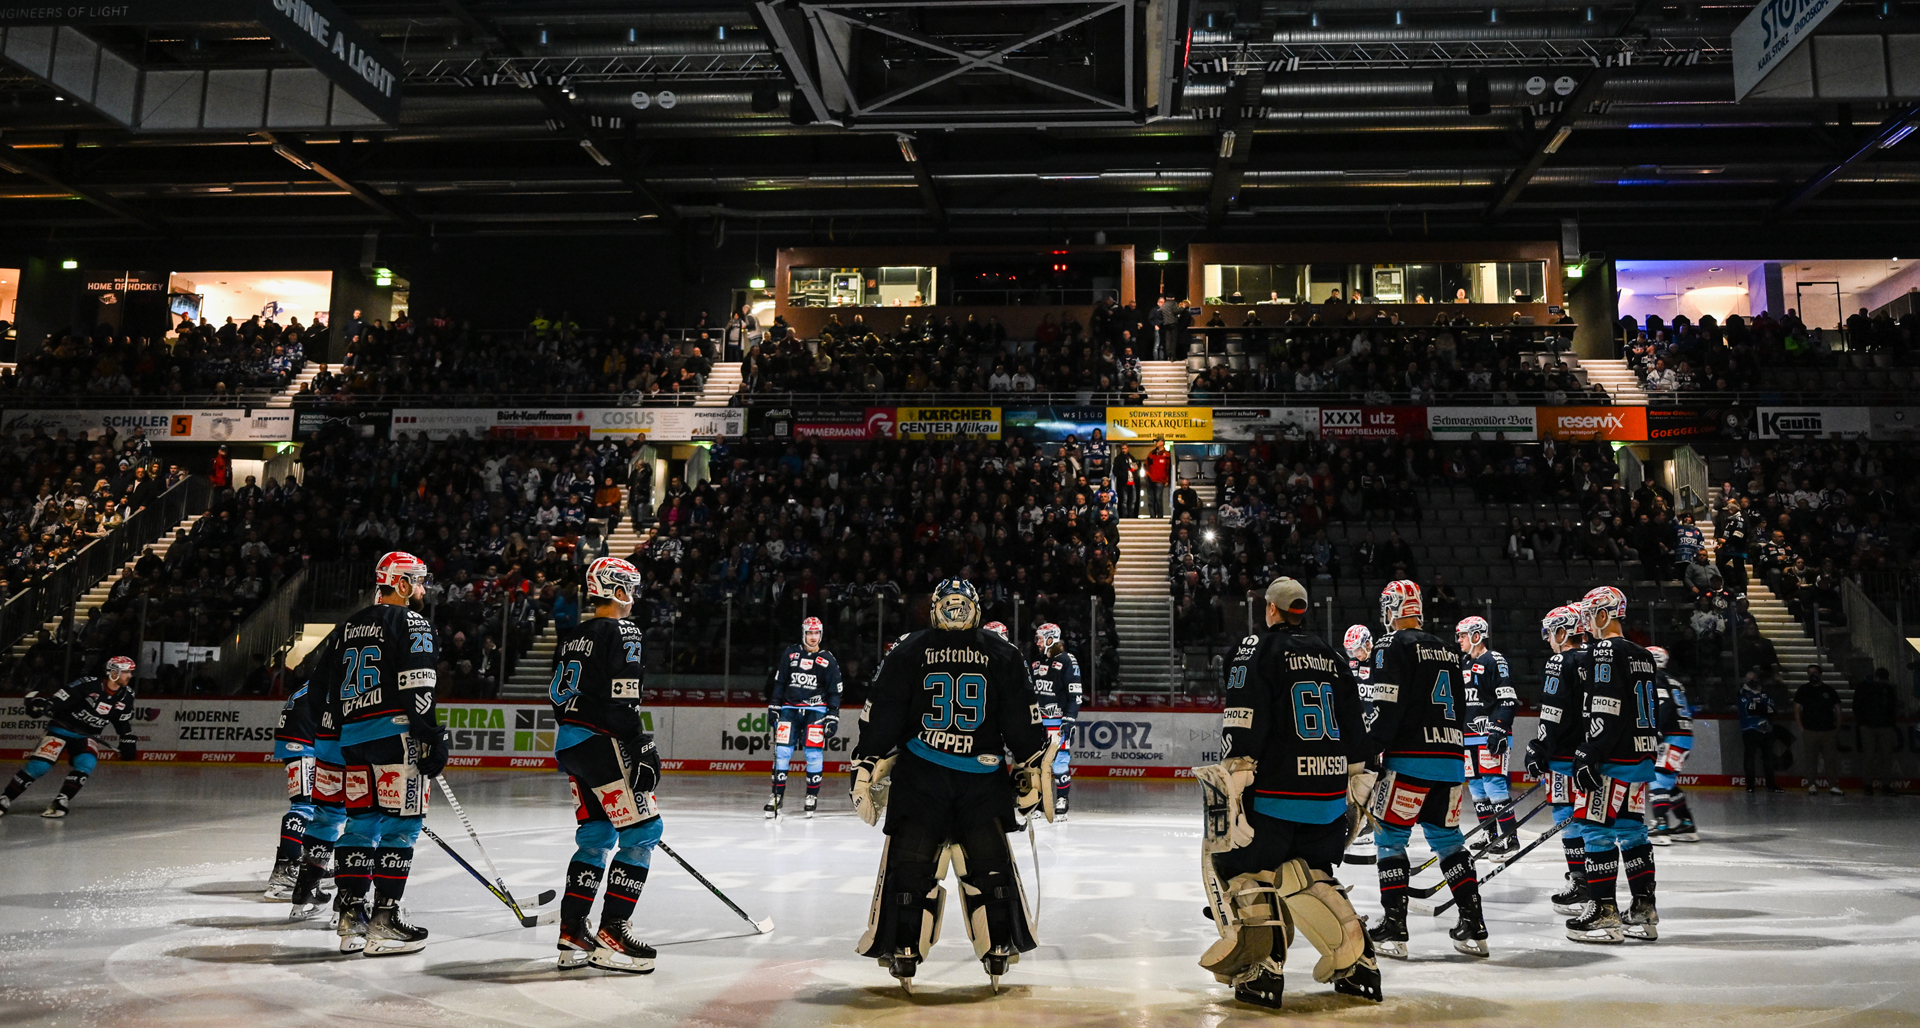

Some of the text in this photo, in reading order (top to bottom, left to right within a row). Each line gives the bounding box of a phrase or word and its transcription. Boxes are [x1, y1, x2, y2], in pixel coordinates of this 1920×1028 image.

[67, 6, 86, 18] OF
[89, 5, 130, 18] LIGHT
[1757, 55, 1772, 71] KARL
[1772, 33, 1790, 57] STORZ
[331, 31, 345, 61] A
[349, 42, 396, 98] LIGHT
[87, 282, 164, 291] HOME OF HOCKEY
[602, 411, 655, 425] COSUS
[1129, 410, 1162, 418] SÜDWEST
[1323, 412, 1360, 424] XXX
[1431, 414, 1533, 426] Schwarzwälder Bote
[102, 416, 169, 427] SCHULER
[899, 422, 998, 433] CENTER Milkau
[1113, 419, 1207, 430] DIE NECKARQUELLE
[1558, 412, 1624, 431] reservix
[1761, 412, 1822, 435] Kauth
[406, 618, 431, 628] best
[618, 626, 643, 635] best
[409, 632, 434, 653] 26
[1375, 648, 1385, 669] 4
[1592, 648, 1614, 657] best
[1545, 660, 1563, 672] best
[340, 645, 382, 701] 26
[790, 671, 818, 686] STORZ
[1226, 665, 1248, 689] 60
[1594, 662, 1612, 683] 18
[1430, 669, 1457, 721] 4
[921, 671, 988, 732] 39
[174, 710, 240, 723] MODERNE
[1290, 680, 1341, 741] 60
[1070, 720, 1153, 750] TORZ
[142, 752, 176, 761] PENNY
[201, 753, 236, 762] PENNY
[446, 757, 481, 766] PENNY
[1111, 751, 1164, 760] ENDOSKOPE
[510, 758, 545, 767] PENNY
[709, 762, 745, 771] PENNY
[1108, 768, 1146, 777] PENNY
[287, 781, 300, 791] ORCA
[378, 788, 401, 798] ORCA
[405, 777, 416, 810] STORZ
[1375, 781, 1388, 811] STORZ
